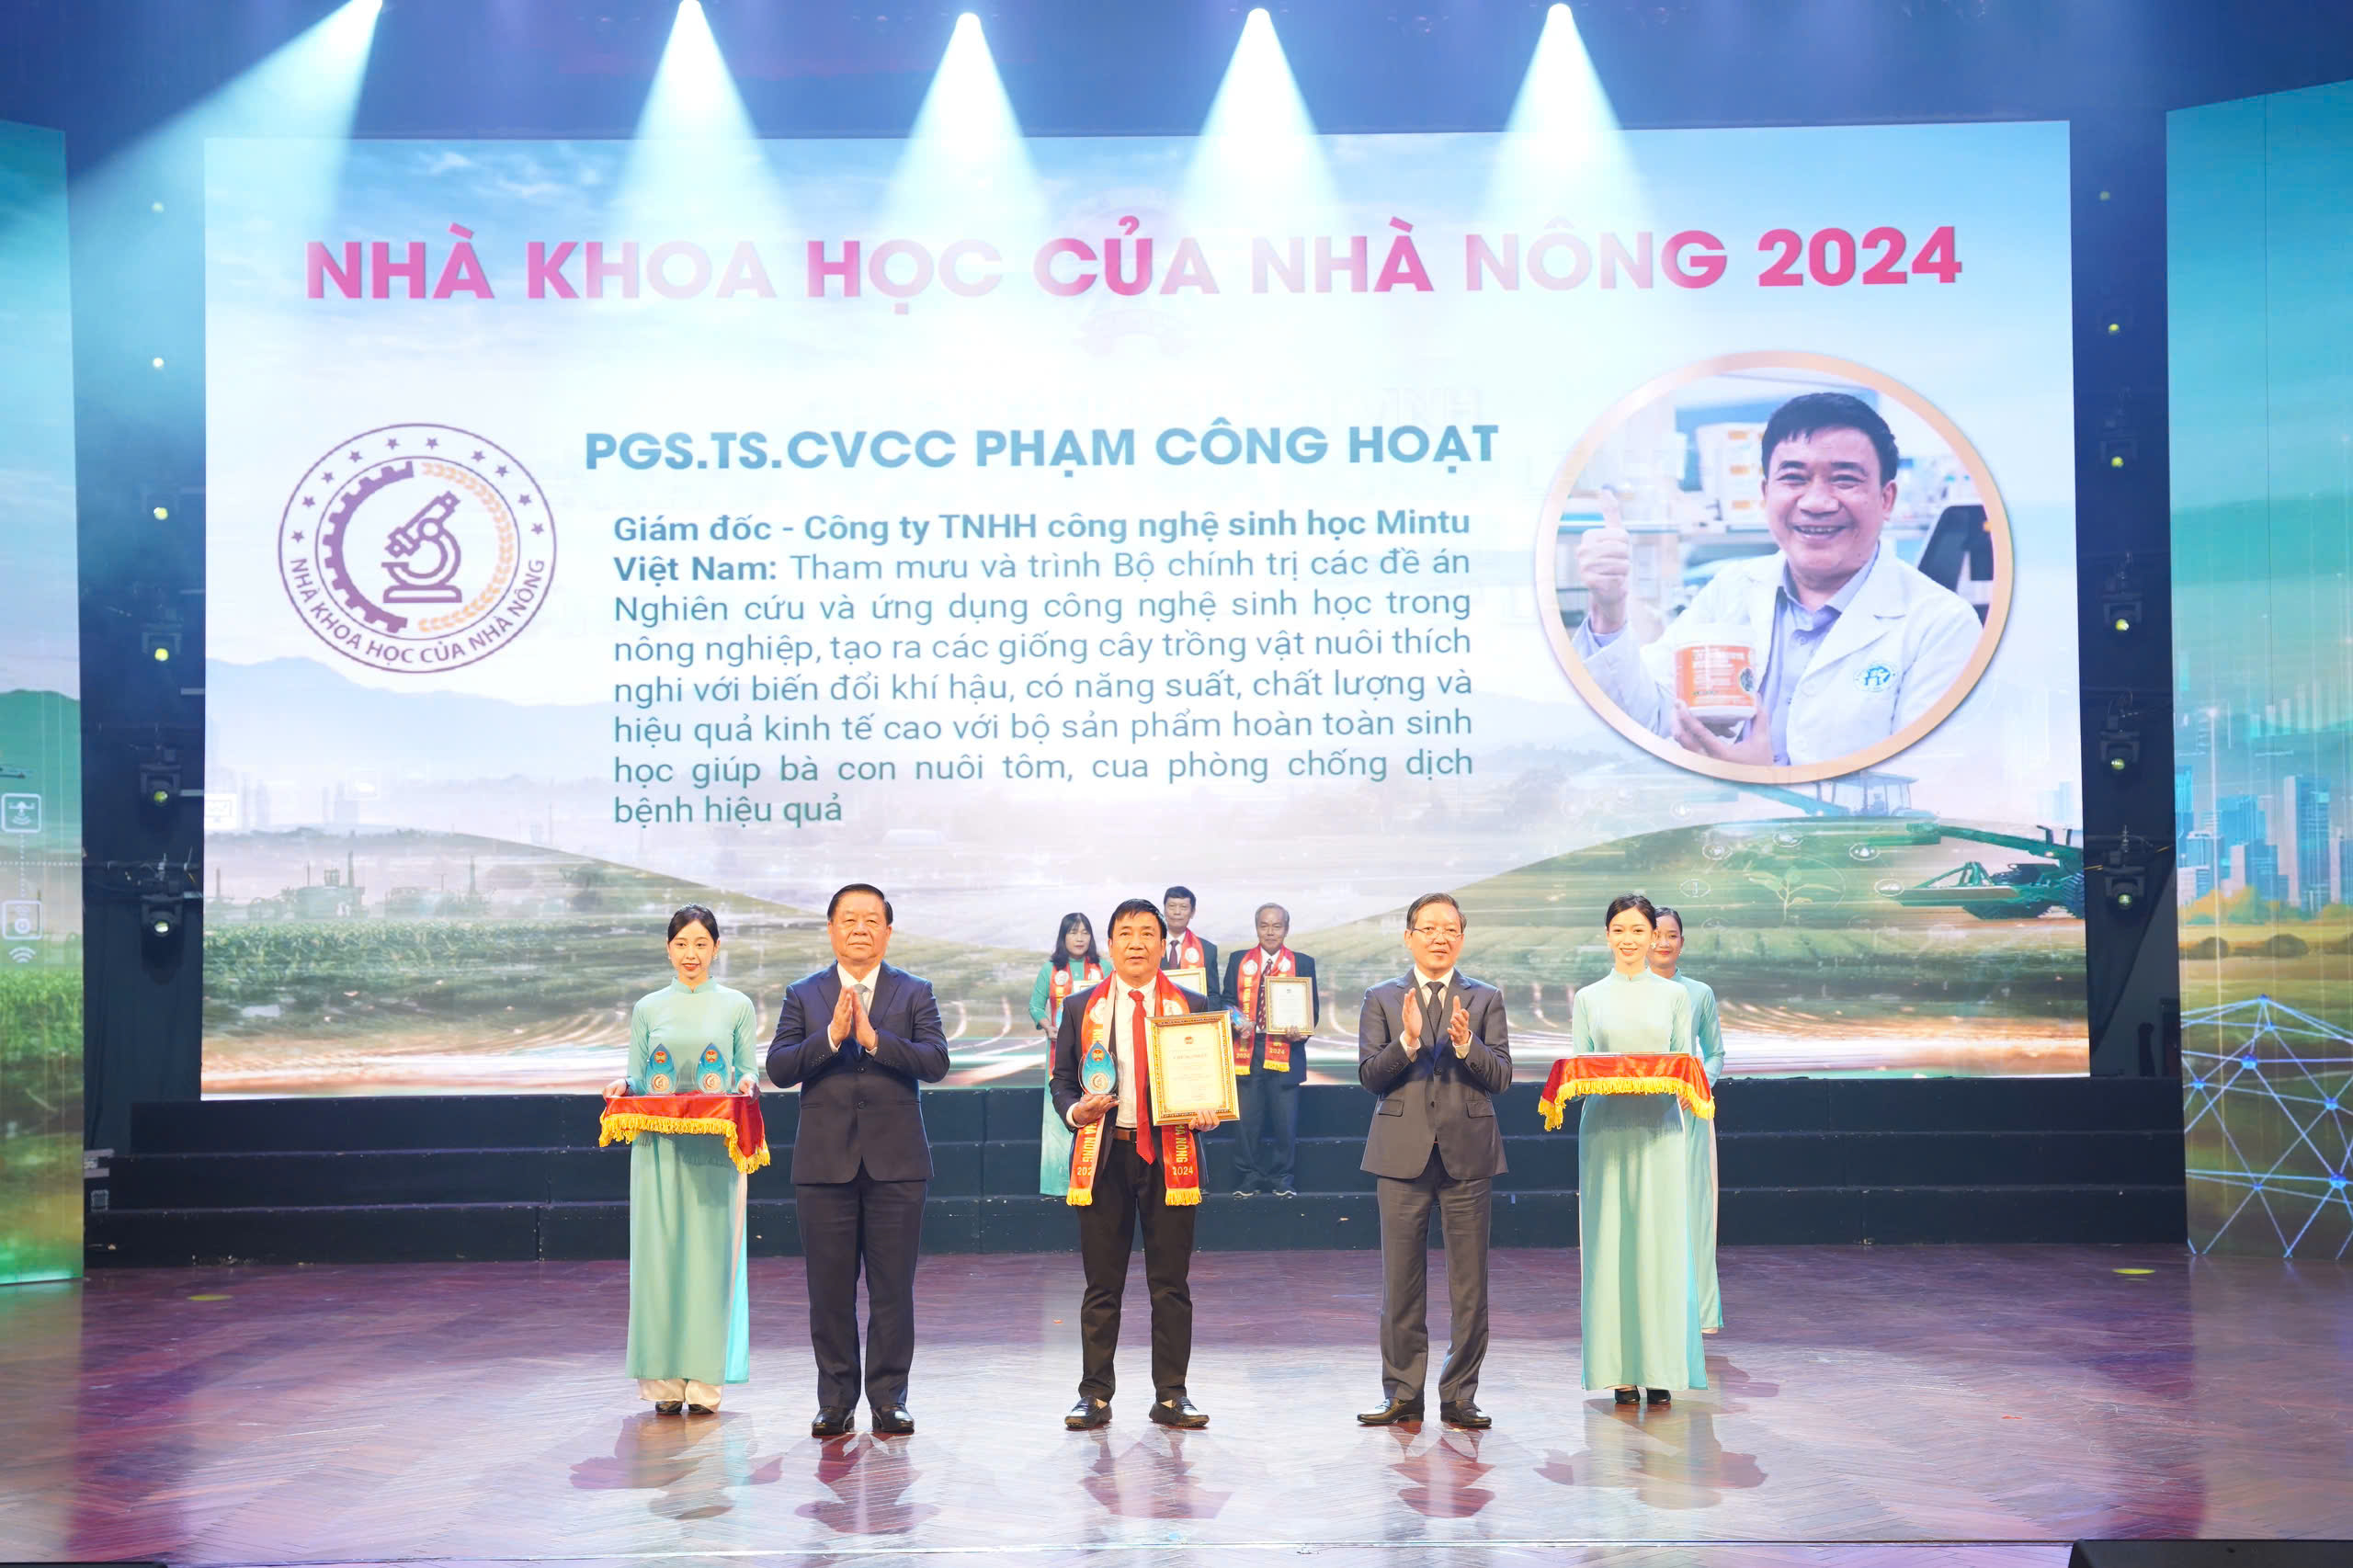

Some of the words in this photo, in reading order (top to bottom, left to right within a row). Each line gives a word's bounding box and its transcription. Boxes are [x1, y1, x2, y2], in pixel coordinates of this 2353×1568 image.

[306, 222, 494, 299] NHÀ
[527, 240, 777, 299] KHOA
[808, 238, 1003, 314] HỌC
[1035, 216, 1219, 297] CỦA
[1251, 217, 1433, 293] NHÀ
[1466, 217, 1728, 290] NÔNG
[1757, 225, 1962, 286] 2024
[585, 429, 957, 471] PGS.TS.CVCC
[975, 428, 1135, 479] PHẠM
[1154, 416, 1329, 466] CÔNG
[1348, 424, 1499, 474] HOẠT
[613, 515, 699, 542] Giám
[709, 514, 772, 541] đốc
[804, 514, 889, 547] Công
[898, 516, 930, 547] ty
[938, 514, 1037, 540] TNHH
[1047, 512, 1127, 545] công
[1138, 510, 1220, 544] nghệ
[1228, 509, 1297, 537] sinh
[1307, 508, 1367, 541] học
[1376, 508, 1470, 535] Mintu
[613, 555, 679, 587] Việt
[691, 555, 777, 582] Nam:
[789, 552, 882, 581] Tham
[896, 558, 968, 579] mưu
[980, 552, 1016, 579] và
[1027, 551, 1100, 578] trình
[1114, 551, 1155, 583] Bộ
[1167, 549, 1254, 577] chính
[1266, 551, 1298, 582] trị
[1310, 549, 1369, 575] các
[1379, 547, 1420, 574] đề
[1432, 548, 1470, 574] án
[290, 558, 321, 603] NHÀ
[310, 602, 362, 649] KHOA
[365, 640, 415, 665] HỌC
[468, 616, 514, 651] NHÀ
[506, 559, 545, 617] NÔNG
[615, 595, 728, 629] Nghiên
[744, 595, 804, 620] cứu
[819, 594, 855, 620] và
[871, 593, 933, 626] ứng
[948, 592, 1029, 625] dụng
[1043, 591, 1122, 624] công
[1139, 590, 1217, 624] nghệ
[1232, 588, 1297, 616] sinh
[1313, 587, 1371, 621] học
[1385, 591, 1471, 621] trong
[614, 635, 694, 668] nông
[705, 633, 821, 668] nghiệp,
[829, 636, 882, 665] tạo
[892, 640, 921, 659] ra
[932, 632, 989, 659] các
[998, 630, 1087, 665] giống
[1098, 631, 1154, 664] cây
[1161, 629, 1246, 663] trồng
[1256, 630, 1304, 662] vật
[1315, 629, 1382, 655] nuôi
[1391, 626, 1471, 654] thích
[614, 676, 683, 710] nghi
[693, 676, 740, 702] với
[751, 673, 818, 701] biến
[830, 671, 879, 701] đổi
[892, 673, 939, 700] khí
[949, 673, 1015, 706] hậu,
[1026, 672, 1063, 699] có
[1074, 672, 1154, 705] năng
[1165, 668, 1242, 700] suất,
[1253, 668, 1323, 697] chất
[1335, 668, 1426, 702] lượng
[1436, 668, 1472, 695] và
[614, 715, 681, 749] hiệu
[693, 712, 753, 749] quả
[764, 714, 830, 742] kinh
[841, 712, 876, 741] tế
[883, 721, 942, 741] cao
[952, 713, 998, 740] với
[1011, 712, 1051, 745] bộ
[1062, 710, 1119, 739] sản
[1131, 708, 1221, 744] phẩm
[1233, 710, 1313, 736] hoàn
[1322, 710, 1394, 736] toàn
[1406, 707, 1472, 735] sinh
[614, 756, 674, 790] học
[691, 756, 761, 790] giúp
[779, 755, 818, 782] bà
[837, 761, 896, 781] con
[915, 754, 983, 780] nuôi
[1002, 753, 1073, 782] tôm,
[1092, 758, 1148, 778] cua
[1168, 750, 1268, 785] phòng
[1288, 747, 1388, 783] chống
[1405, 747, 1472, 781] dịch
[614, 795, 693, 829] bệnh
[705, 795, 772, 828] hiệu
[782, 791, 842, 829] quả
[1076, 1165, 1092, 1176] 202
[1172, 1165, 1194, 1176] 2024
